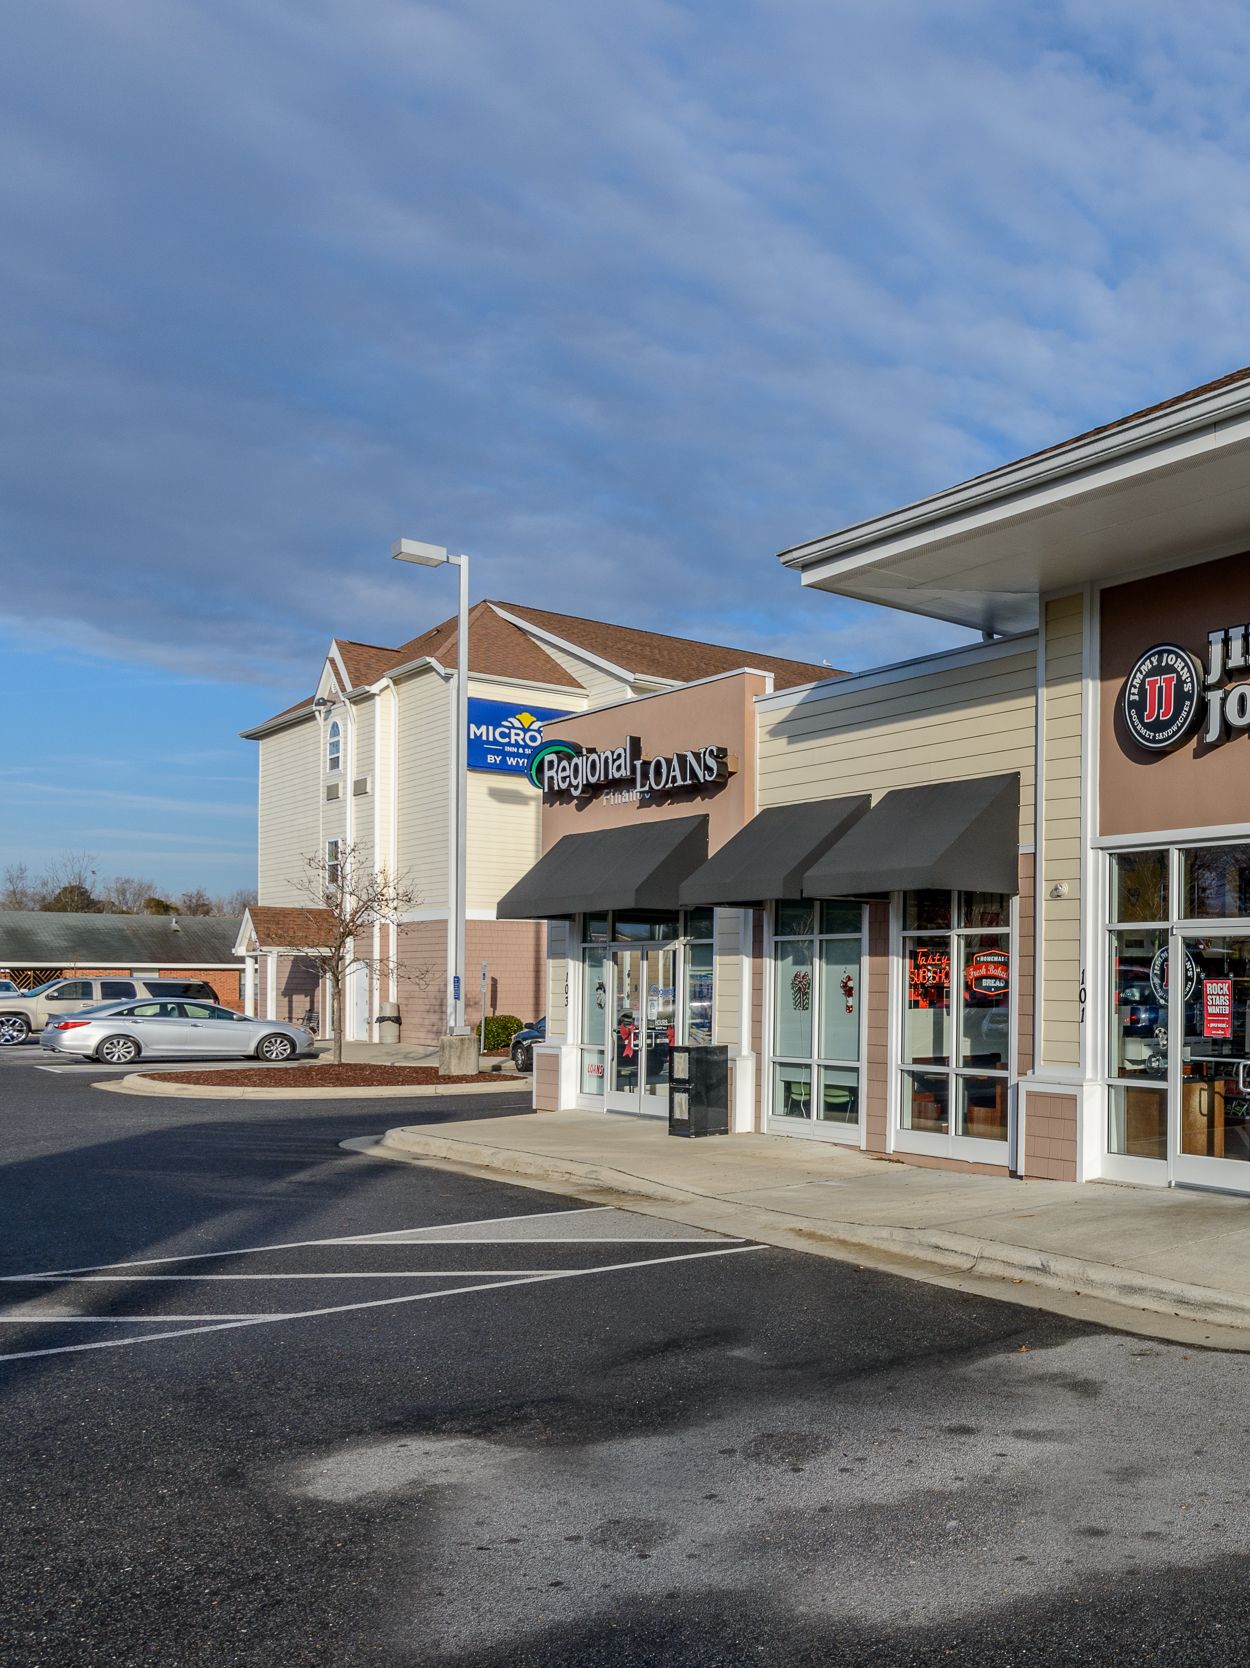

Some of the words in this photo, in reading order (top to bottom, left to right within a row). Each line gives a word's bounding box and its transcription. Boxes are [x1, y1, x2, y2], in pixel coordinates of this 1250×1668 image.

[1129, 653, 1158, 701] JIMMY
[1161, 653, 1192, 693] JOHN'S
[1144, 673, 1177, 723] JJ
[1130, 708, 1154, 740] GOURMET
[1155, 700, 1191, 740] SANDWICHES
[469, 723, 543, 747] MICRO
[487, 754, 502, 764] BY
[543, 735, 630, 796] Regional
[634, 745, 719, 792] LOANS
[916, 947, 950, 967] Tasty
[909, 968, 928, 984] SUB
[969, 964, 986, 979] Fresh
[982, 978, 1006, 987] BREAD
[1206, 983, 1230, 995] ROCK
[1079, 968, 1087, 1024] 101
[1207, 995, 1230, 1006] STARS
[1207, 1005, 1230, 1014] WANTED
